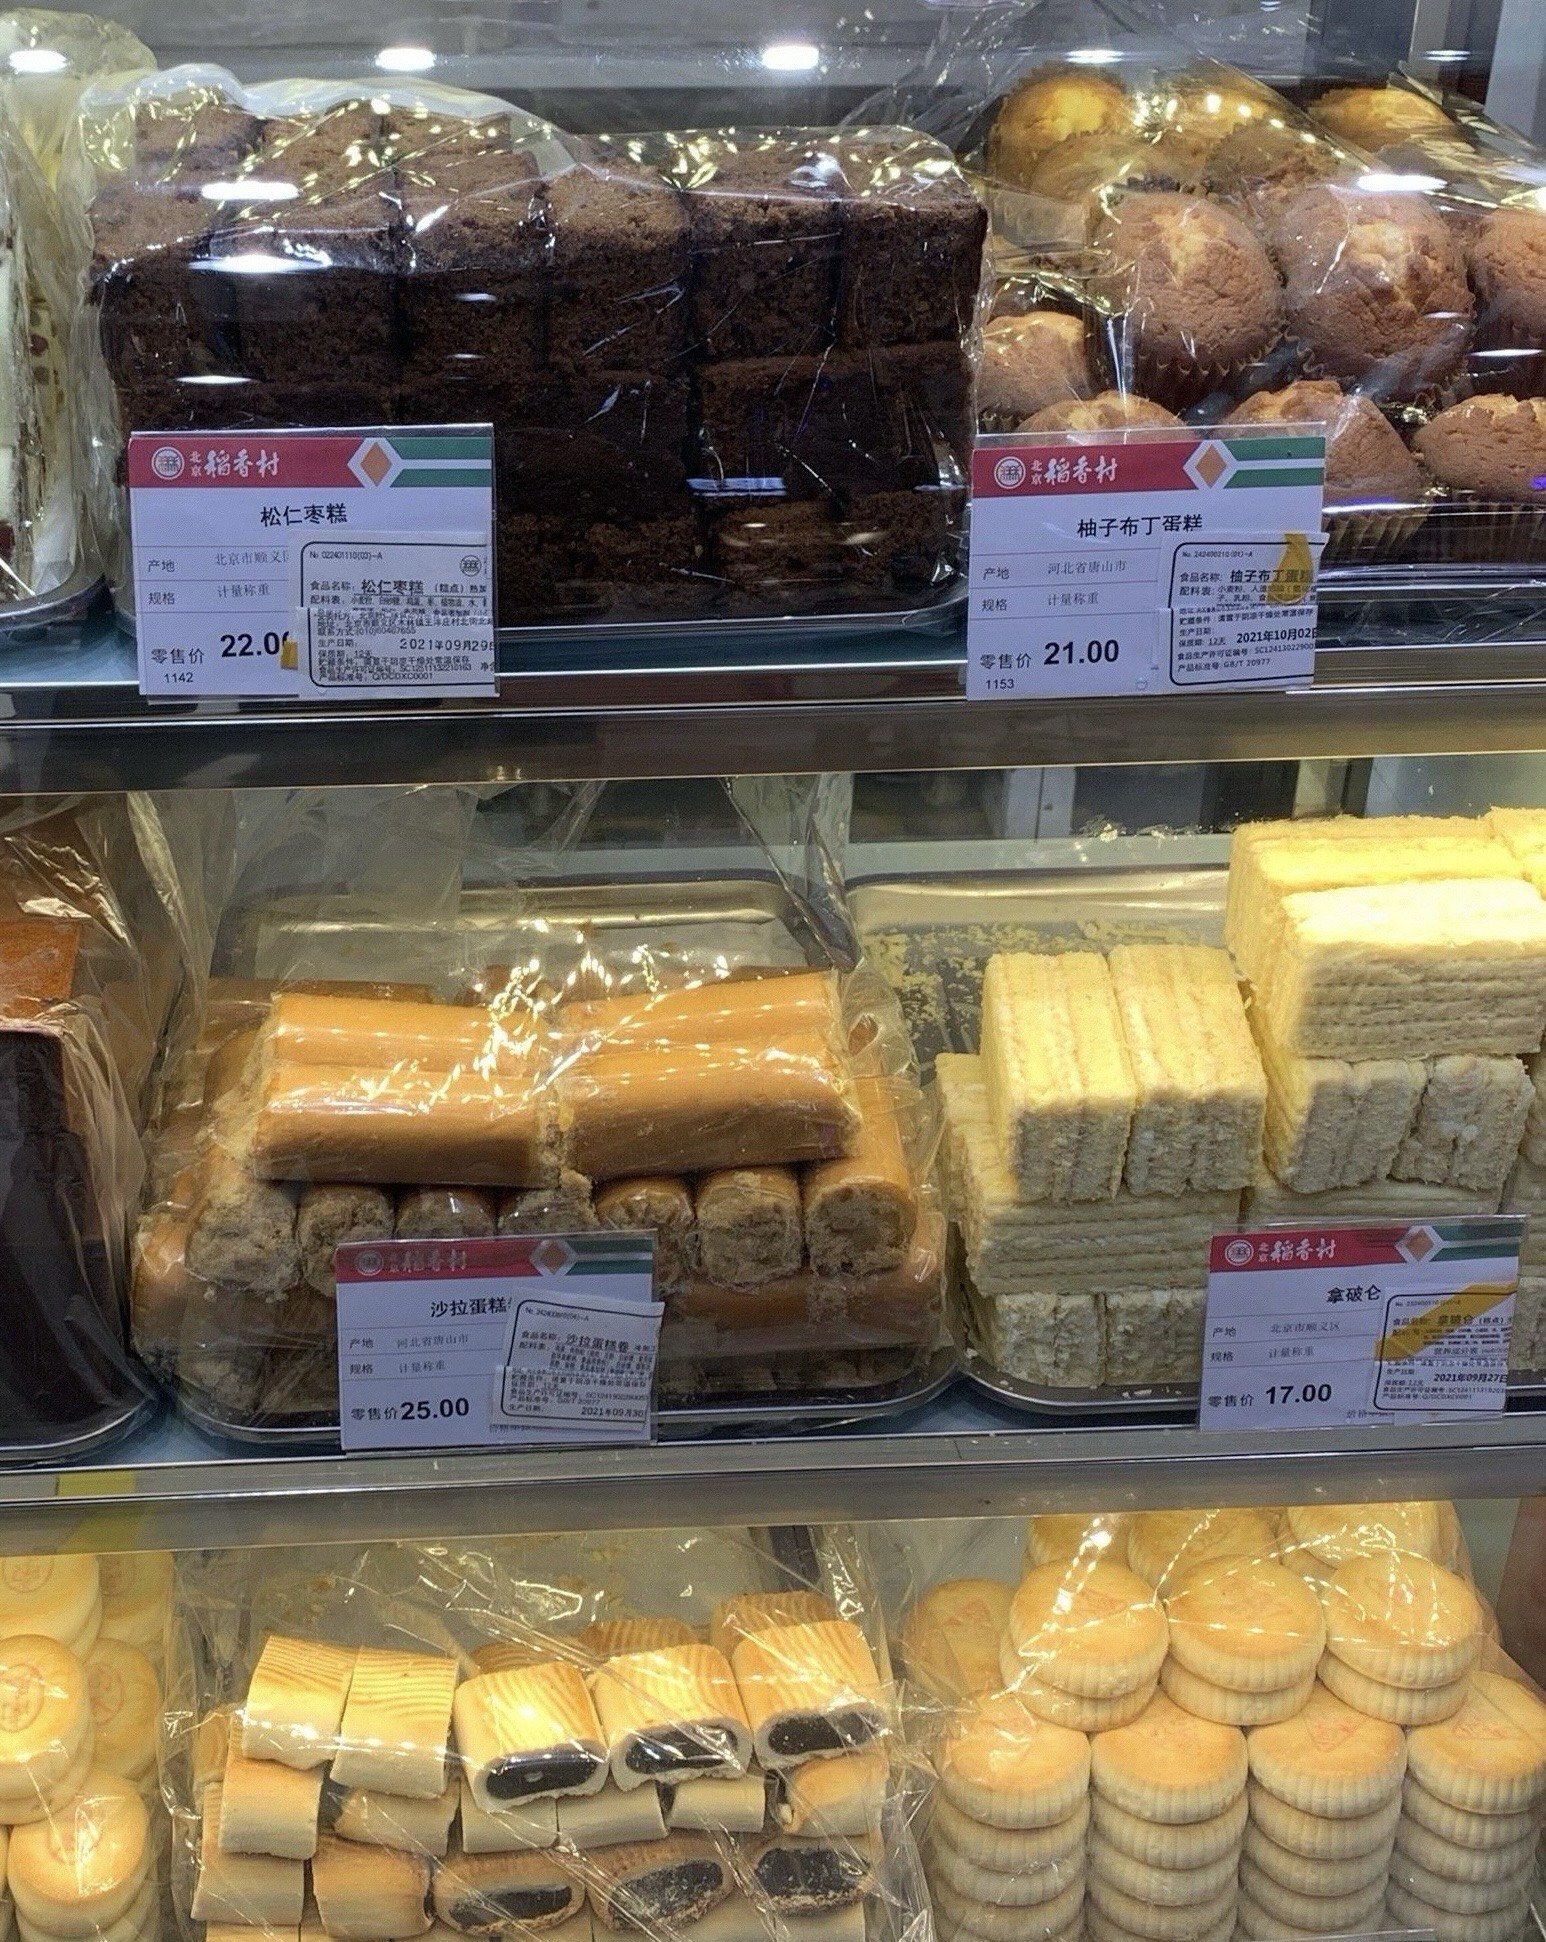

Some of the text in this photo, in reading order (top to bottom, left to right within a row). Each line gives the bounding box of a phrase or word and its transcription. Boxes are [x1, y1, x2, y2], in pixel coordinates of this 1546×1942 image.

[203, 448, 280, 478] 稻香村
[1043, 455, 1119, 486] 稻香村
[260, 503, 348, 527] 松仁枣糕
[1077, 514, 1203, 539] 柚子布丁蛋糕
[148, 559, 175, 573] 产地
[982, 559, 1127, 580] 产地 河北省唐山市
[148, 583, 269, 605] 规格 计量称重
[360, 579, 424, 597] 松仁枣糕
[981, 592, 1099, 612] 规格 计量称重
[151, 648, 205, 664] 零售价
[980, 639, 1120, 669] 零售价 21.00
[164, 673, 194, 684] 1142
[985, 678, 1015, 690] 1153
[1269, 1238, 1337, 1263] 稻香村
[1327, 1284, 1381, 1304] 拿破仑
[430, 1297, 512, 1318] 沙拉蛋糕
[1212, 1321, 1341, 1338] 产地 北京市顺义区
[349, 1334, 468, 1349] 产地 河北省唐山市
[1210, 1346, 1315, 1362] 规格 计量称重
[350, 1361, 445, 1374] 规格 计量称重
[1207, 1384, 1332, 1407] 零售价 17.00
[351, 1398, 470, 1421] 零售价 25.00
